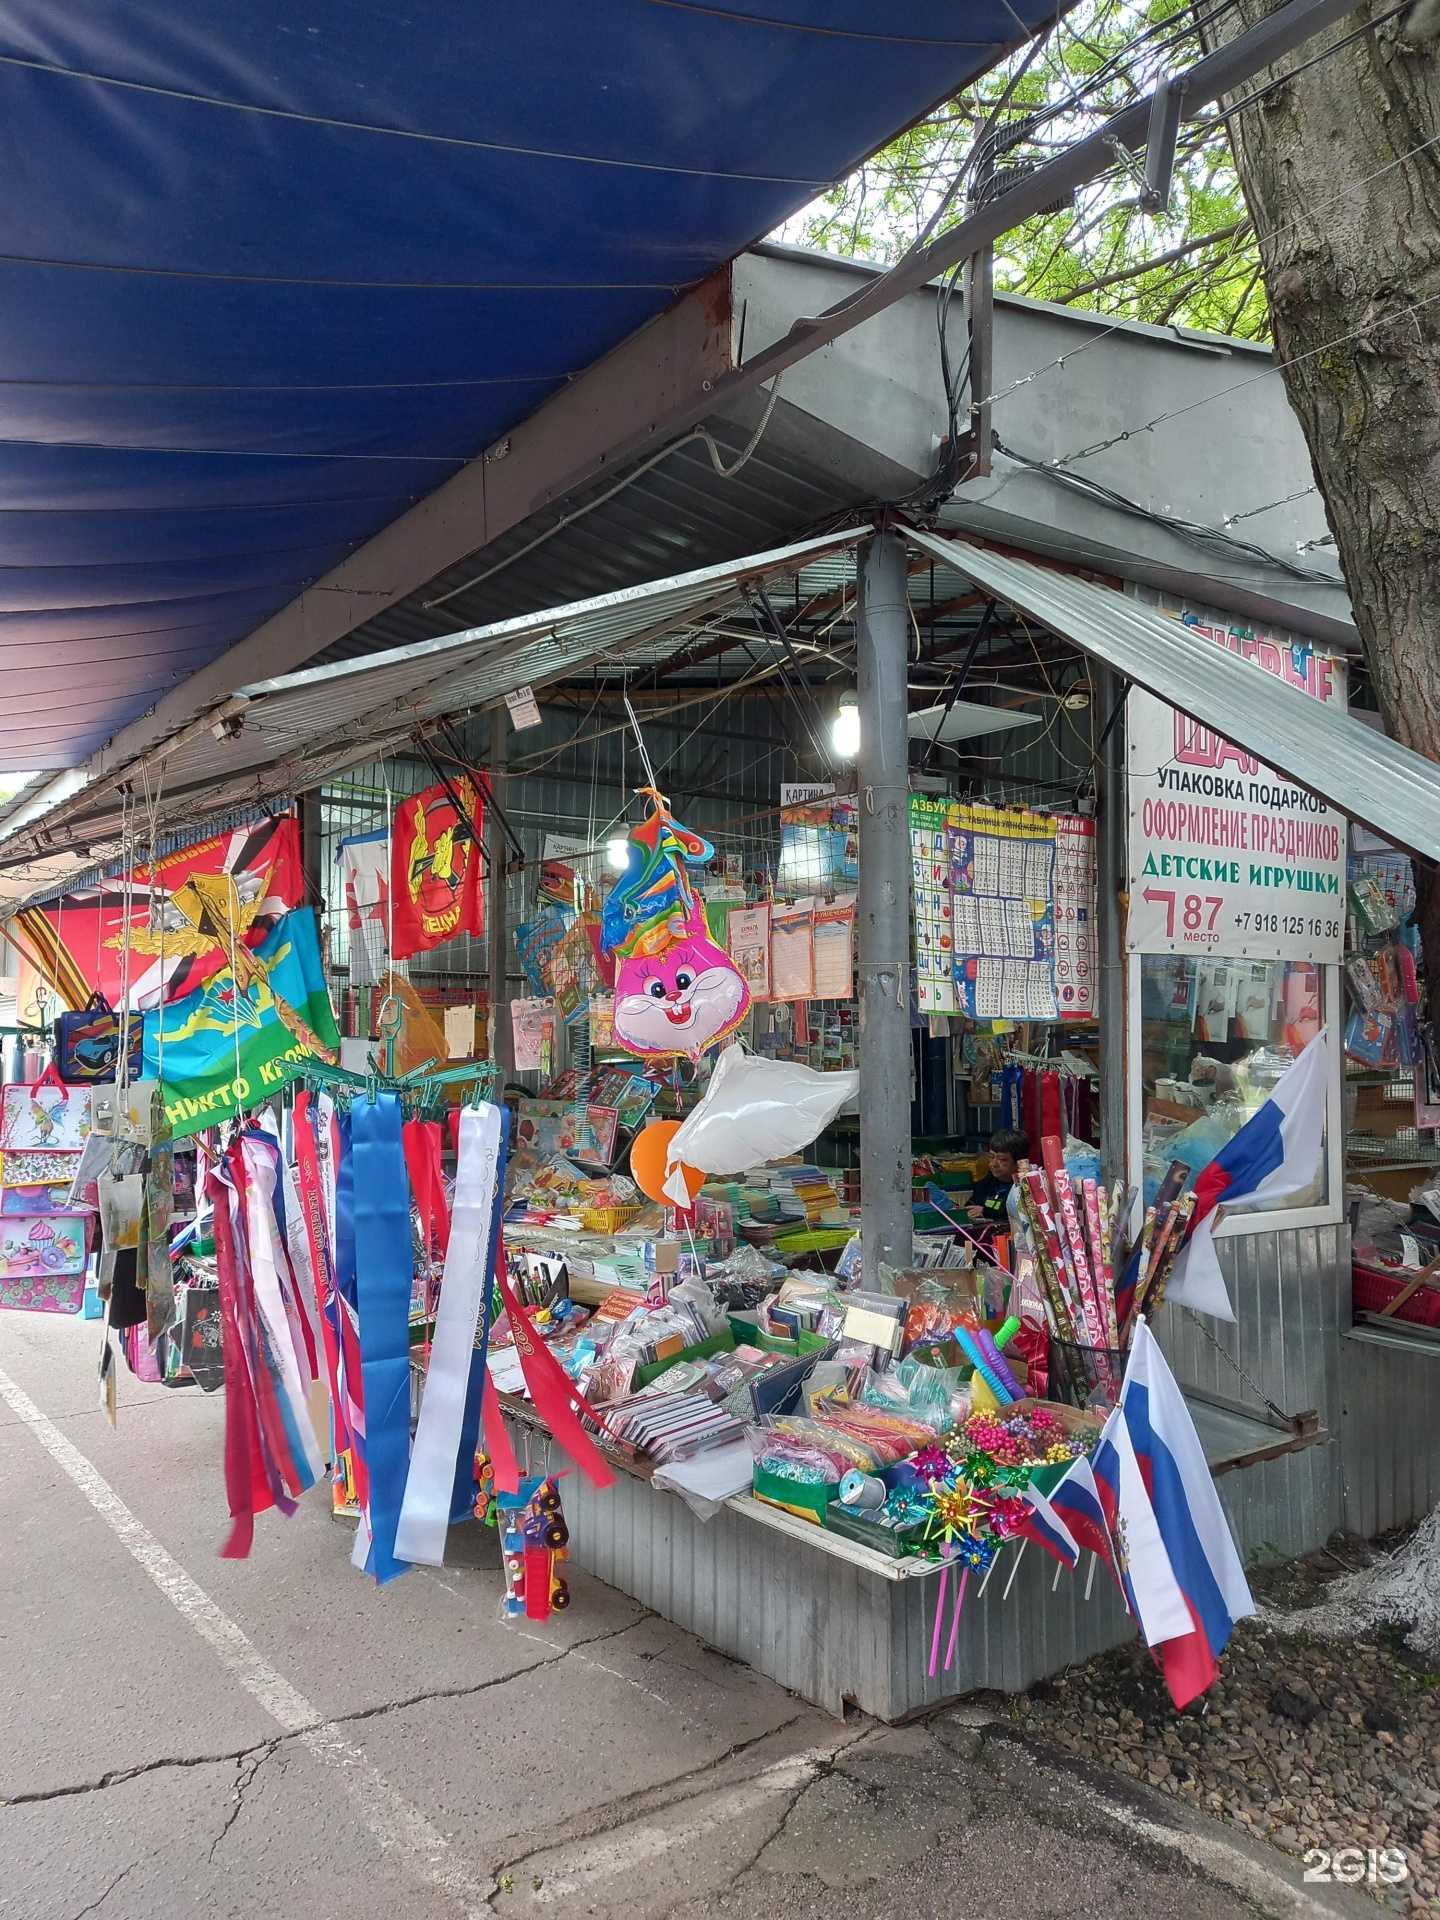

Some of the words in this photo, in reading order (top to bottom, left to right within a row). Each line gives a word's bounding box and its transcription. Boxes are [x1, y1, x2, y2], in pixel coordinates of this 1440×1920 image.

[911, 798, 946, 814] АЗБУК
[1157, 767, 1244, 801] УПАКОВКА
[1249, 783, 1327, 814] ПОДАРКОВ
[1142, 797, 1248, 850] ОФОРМЛЕНИЕ
[1251, 813, 1339, 863] ПРАЗДНИКОВ
[1141, 849, 1240, 884] ДЕТСКИЕ
[1249, 864, 1339, 895] ИГРУШКИ
[1182, 894, 1224, 931] 87
[1234, 912, 1251, 931] +7
[1254, 913, 1278, 933] 918
[1282, 916, 1304, 935] 125
[1308, 919, 1322, 937] 16
[1325, 921, 1339, 938] 36
[1183, 931, 1220, 943] место
[164, 1077, 250, 1125] НИКТО
[258, 1042, 312, 1085] КРОМ
